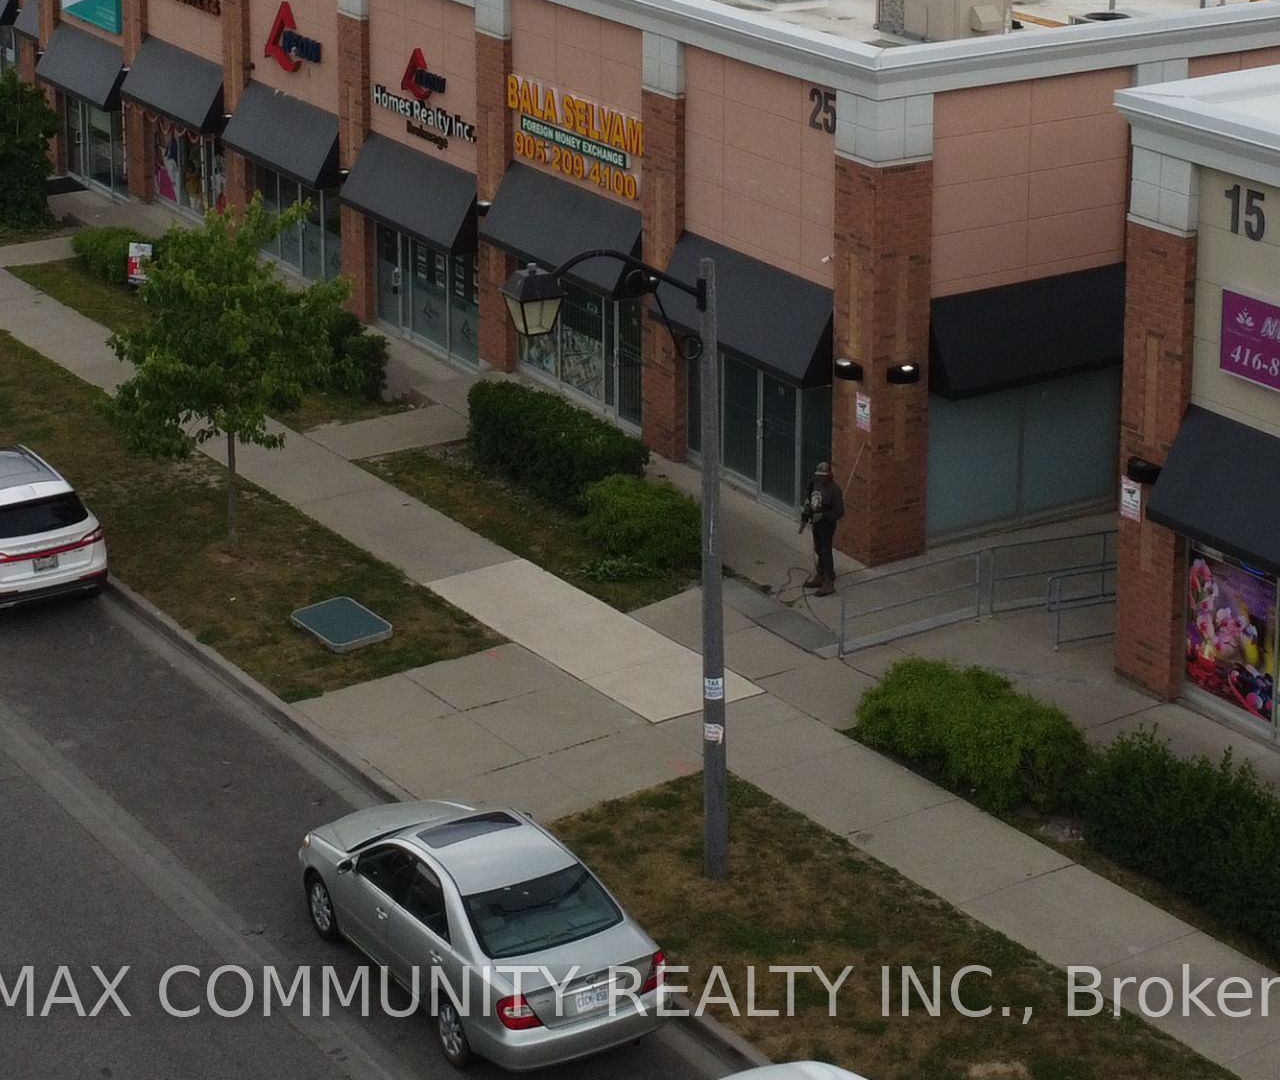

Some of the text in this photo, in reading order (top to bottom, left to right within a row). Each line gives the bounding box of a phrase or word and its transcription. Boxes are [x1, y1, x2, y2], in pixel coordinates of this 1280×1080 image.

[373, 84, 477, 143] Homes Realty Inc.
[507, 74, 644, 157] BALA SELVAM
[809, 88, 837, 134] 25
[514, 131, 637, 201] 905 209 4100
[521, 118, 625, 167] FOREIGN MONEY EXCHANGE
[1224, 183, 1266, 241] 15
